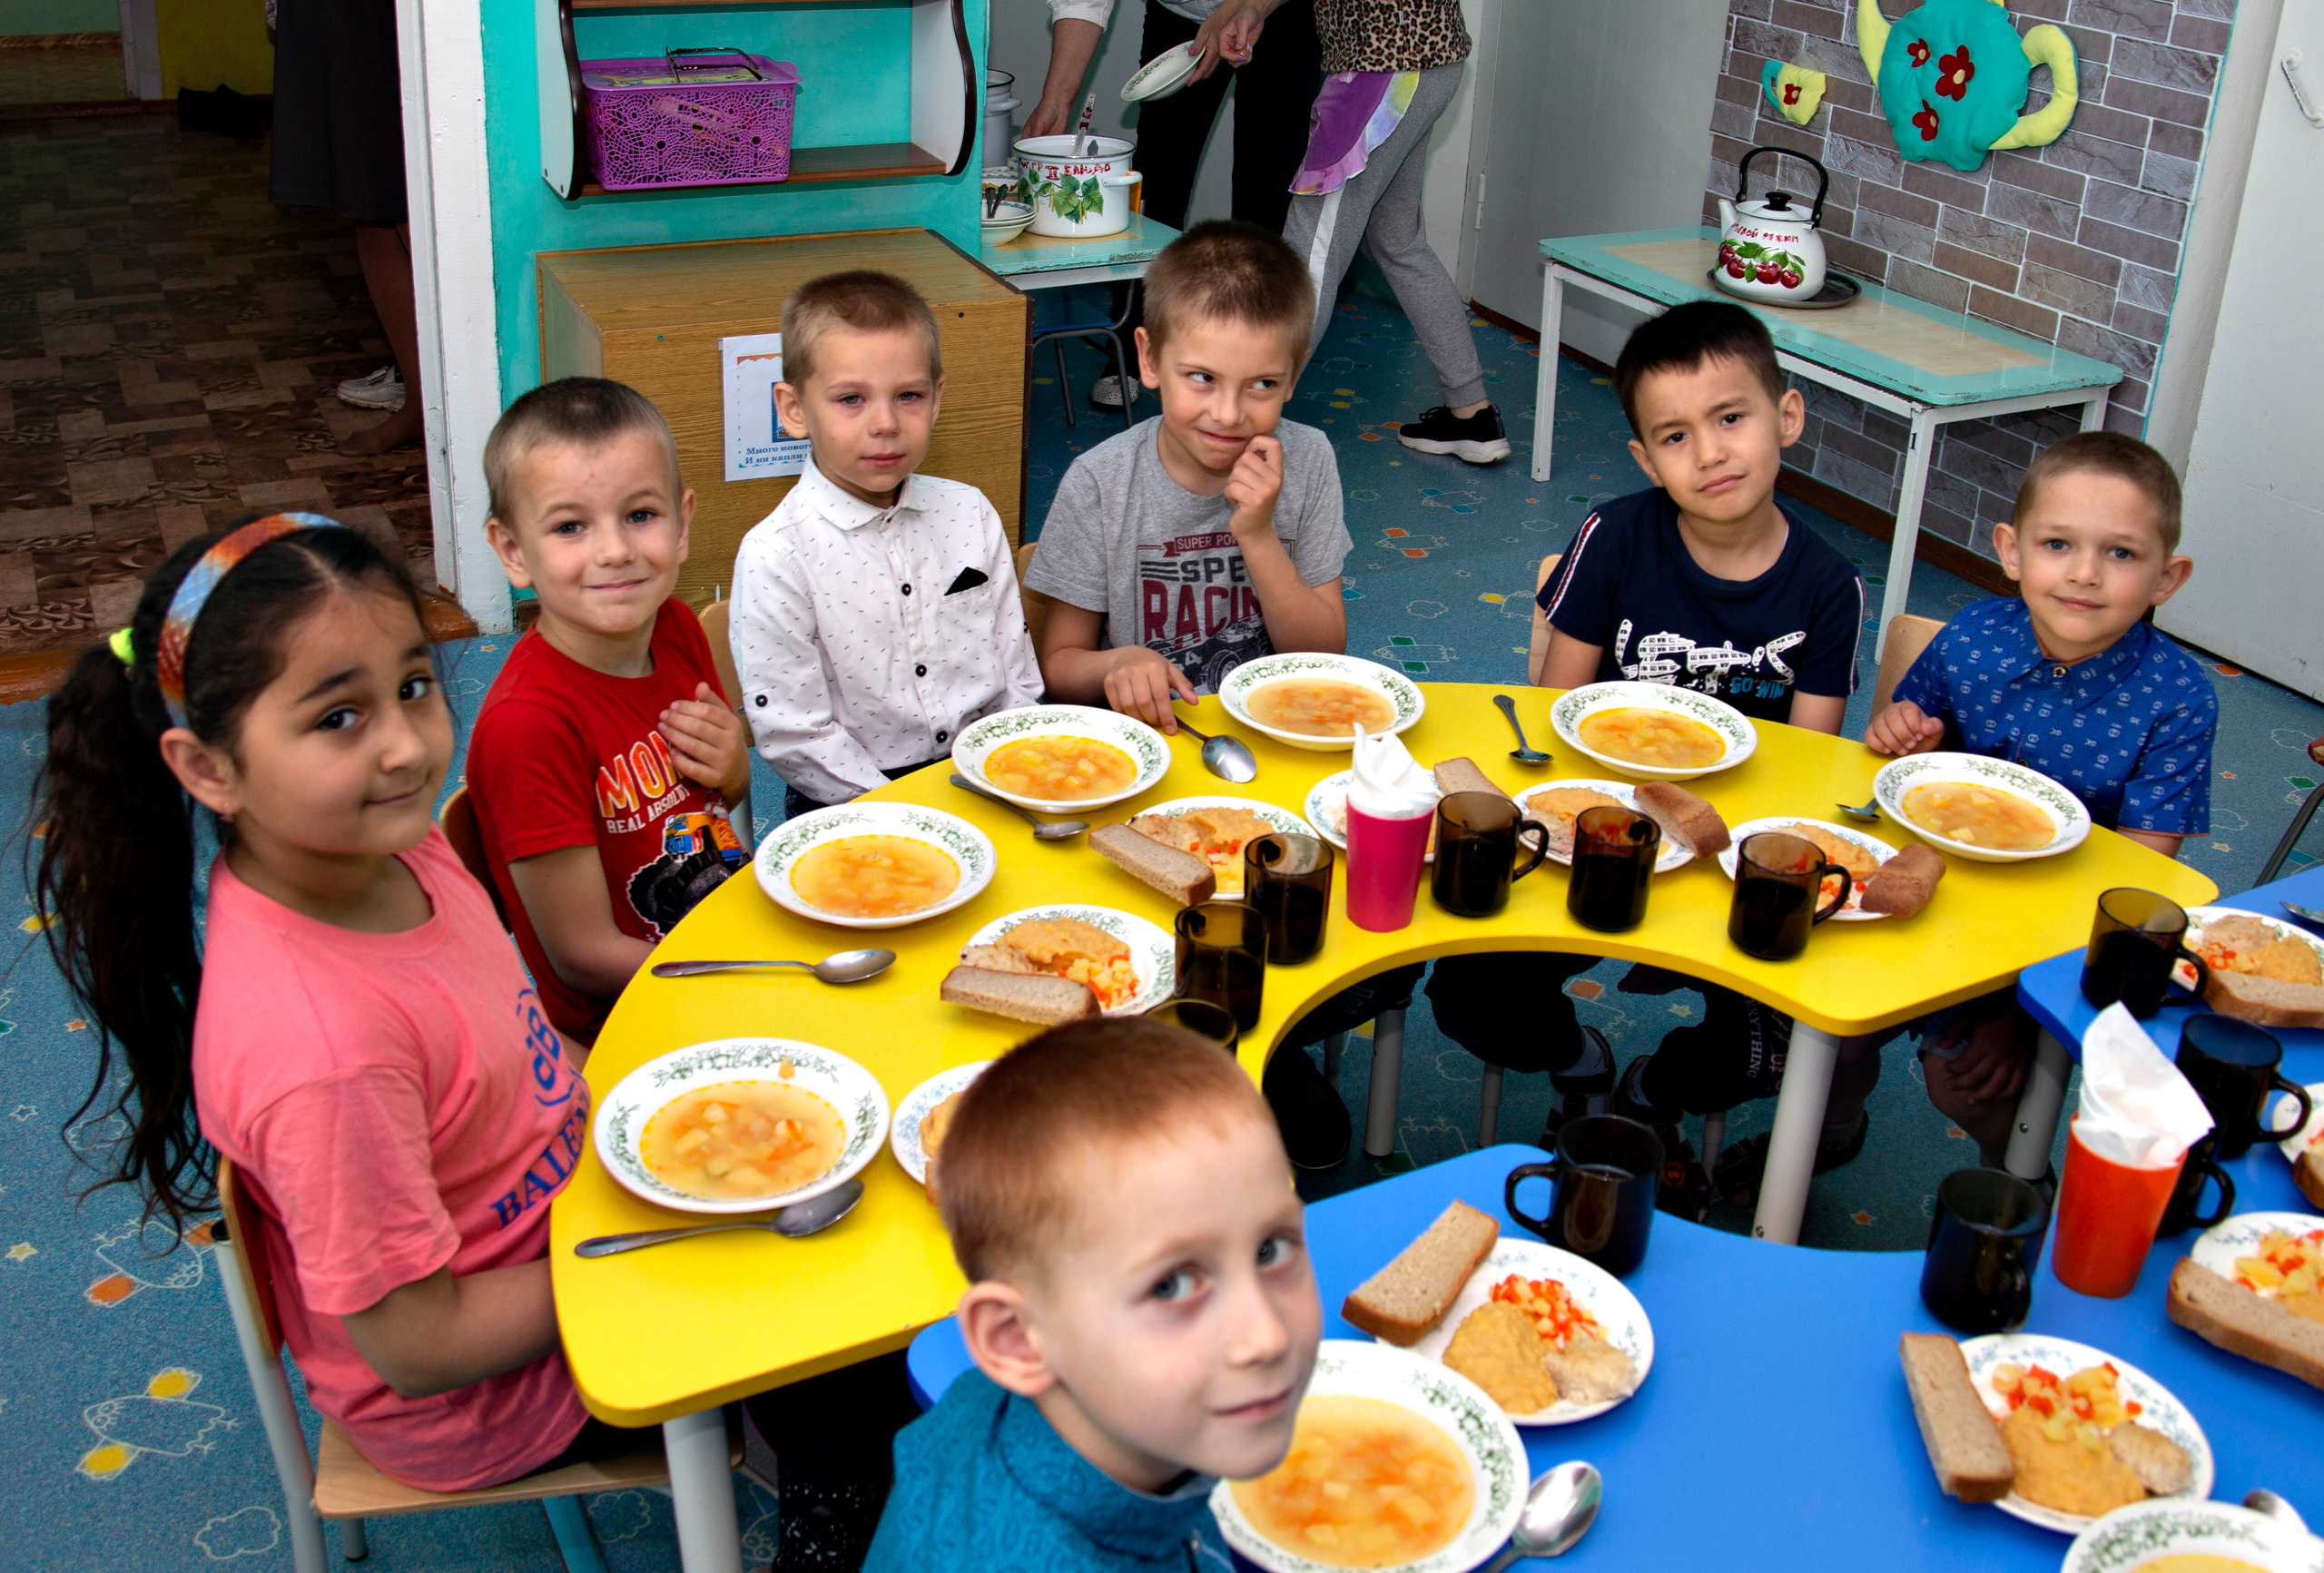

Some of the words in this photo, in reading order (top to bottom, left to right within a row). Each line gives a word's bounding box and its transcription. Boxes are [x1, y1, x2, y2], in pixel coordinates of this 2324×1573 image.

[746, 447, 778, 455] Много
[772, 454, 803, 462] капли
[1177, 536, 1212, 550] SUPER
[1731, 676, 1754, 694] GO
[1755, 680, 1787, 699] WIN
[606, 813, 646, 833] REAL
